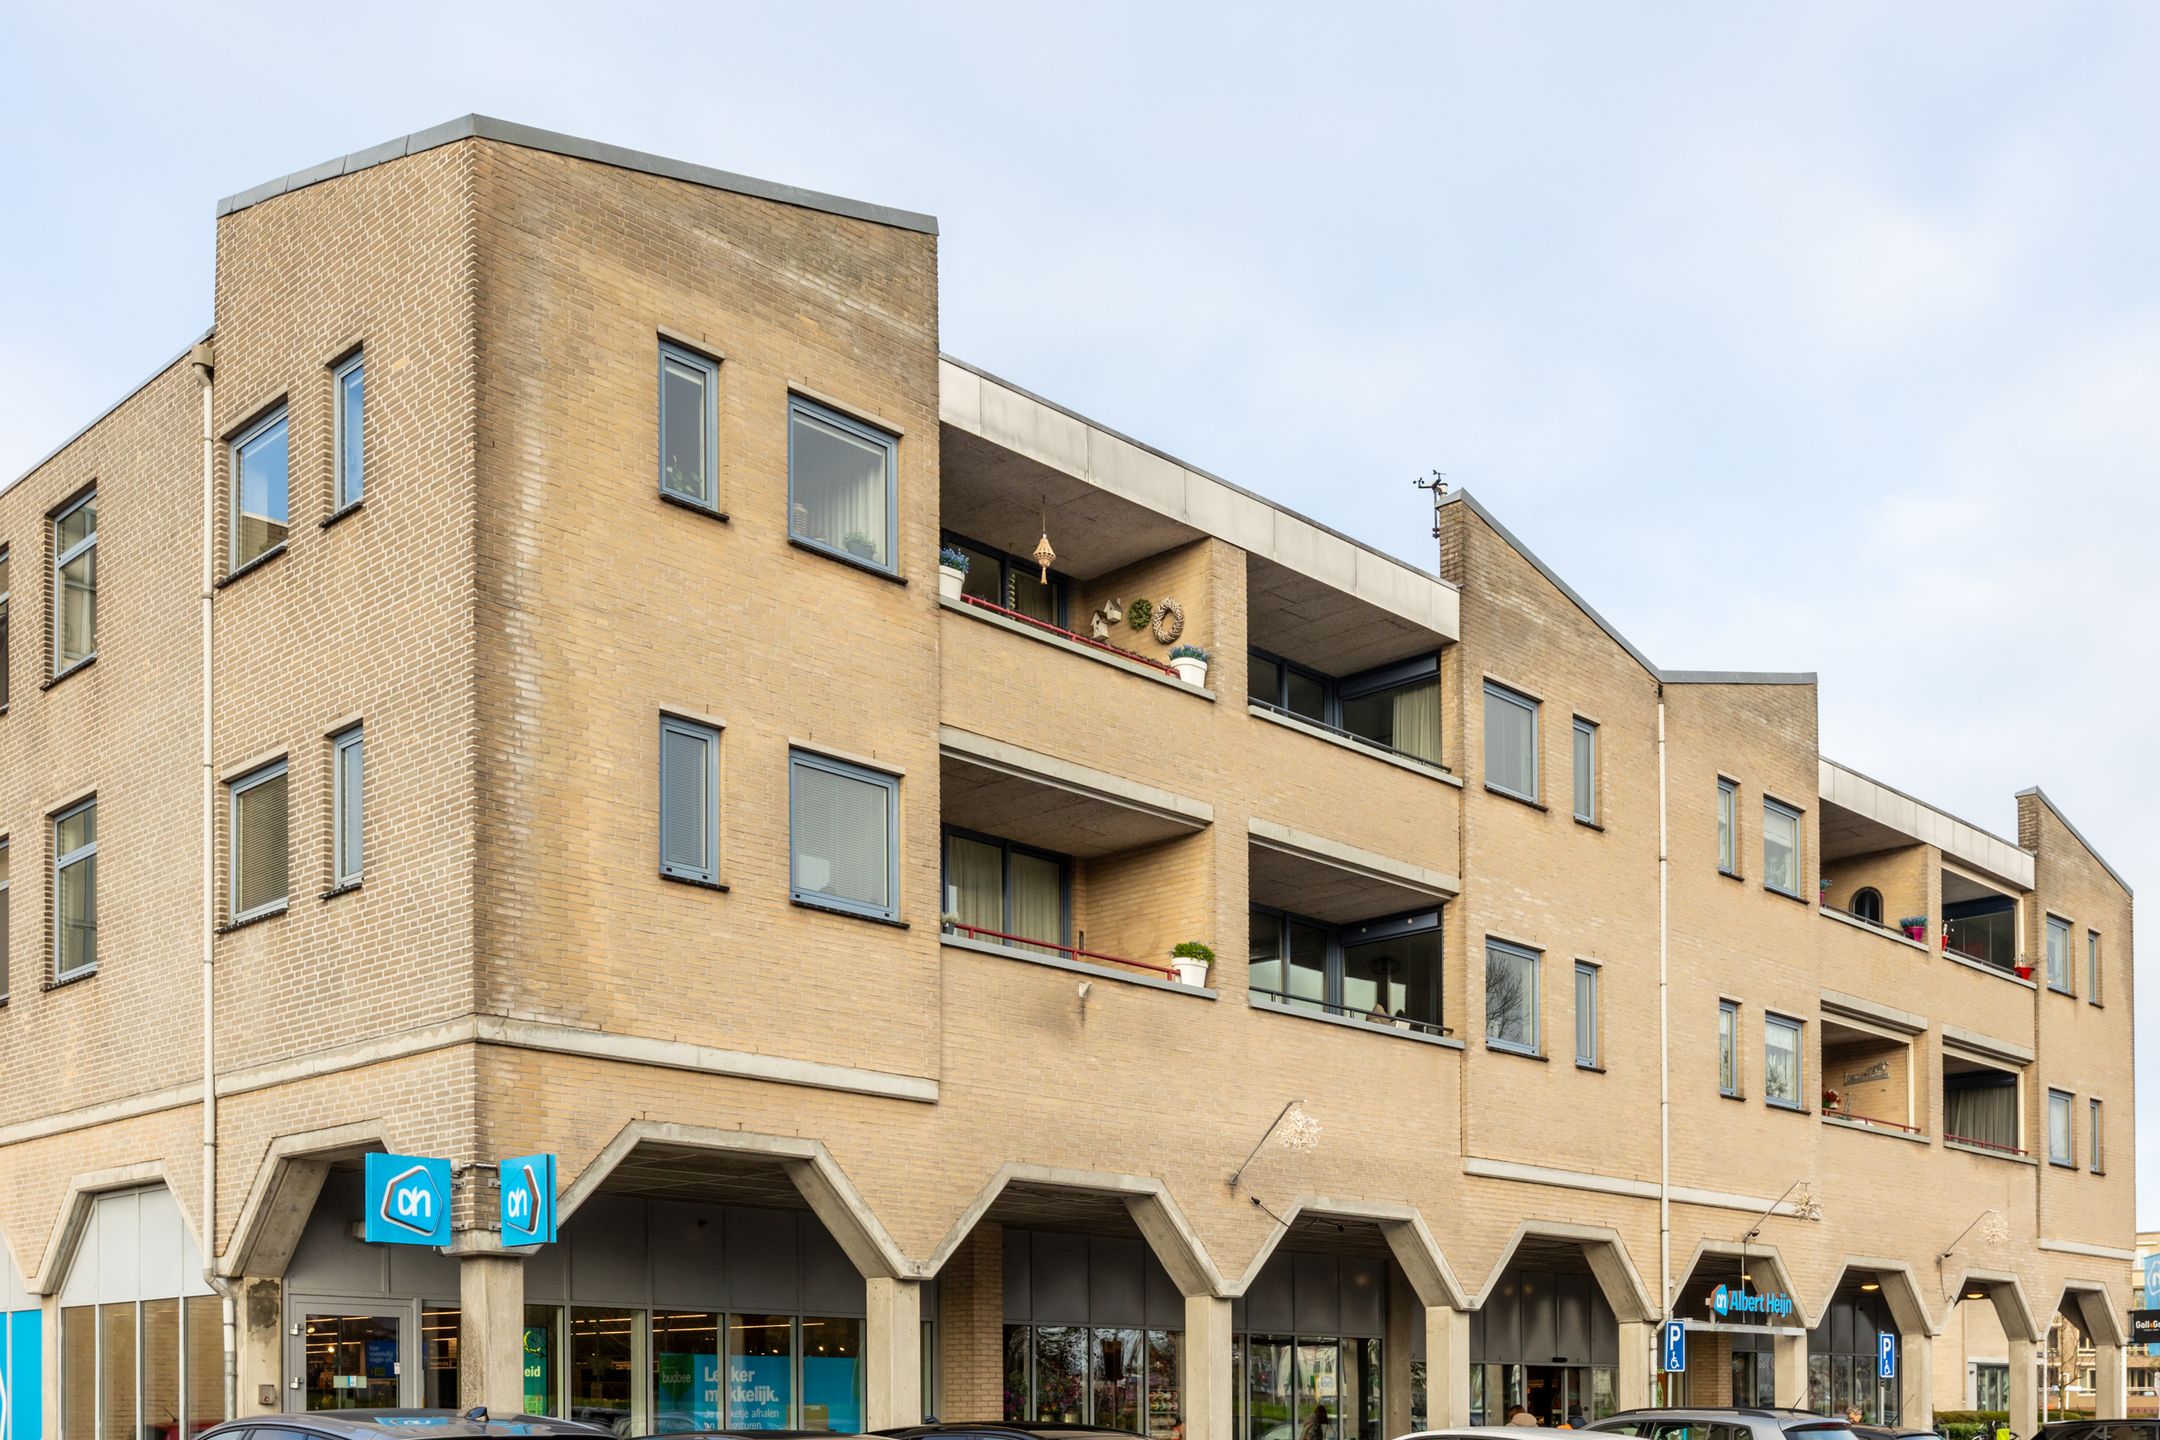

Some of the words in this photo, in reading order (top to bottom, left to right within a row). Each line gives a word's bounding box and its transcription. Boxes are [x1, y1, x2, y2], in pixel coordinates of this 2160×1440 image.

[1730, 1290, 1765, 1313] Albert
[1767, 1293, 1793, 1318] Heijn
[1670, 1325, 1681, 1351] P
[1883, 1337, 1892, 1360] P
[704, 1366, 755, 1382] Leker
[704, 1386, 779, 1405] mkkelijk.
